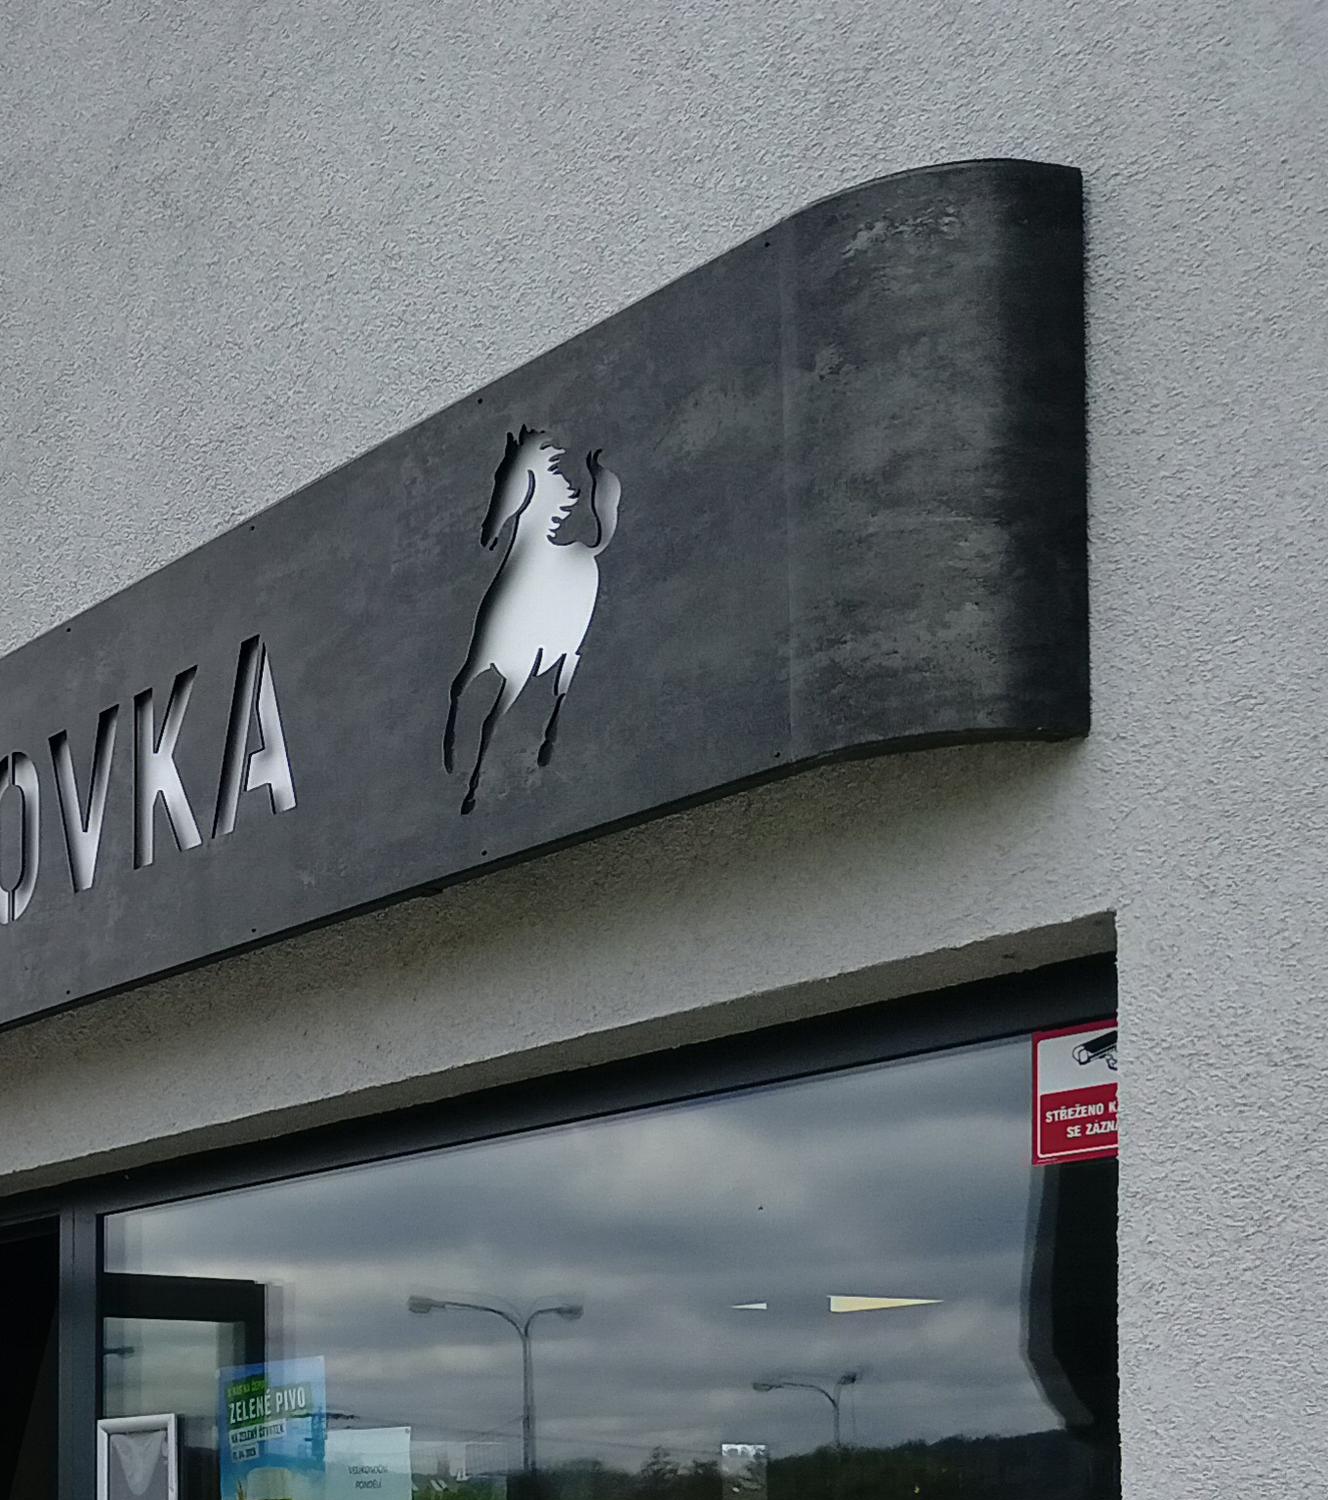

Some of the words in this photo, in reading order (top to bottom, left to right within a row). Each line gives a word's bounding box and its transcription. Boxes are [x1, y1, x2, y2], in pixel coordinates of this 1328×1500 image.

[1046, 1103, 1104, 1122] STŘEŽENO
[1066, 1126, 1082, 1137] SE
[228, 1388, 271, 1425] ZELENÉ
[275, 1386, 306, 1413] PIVO
